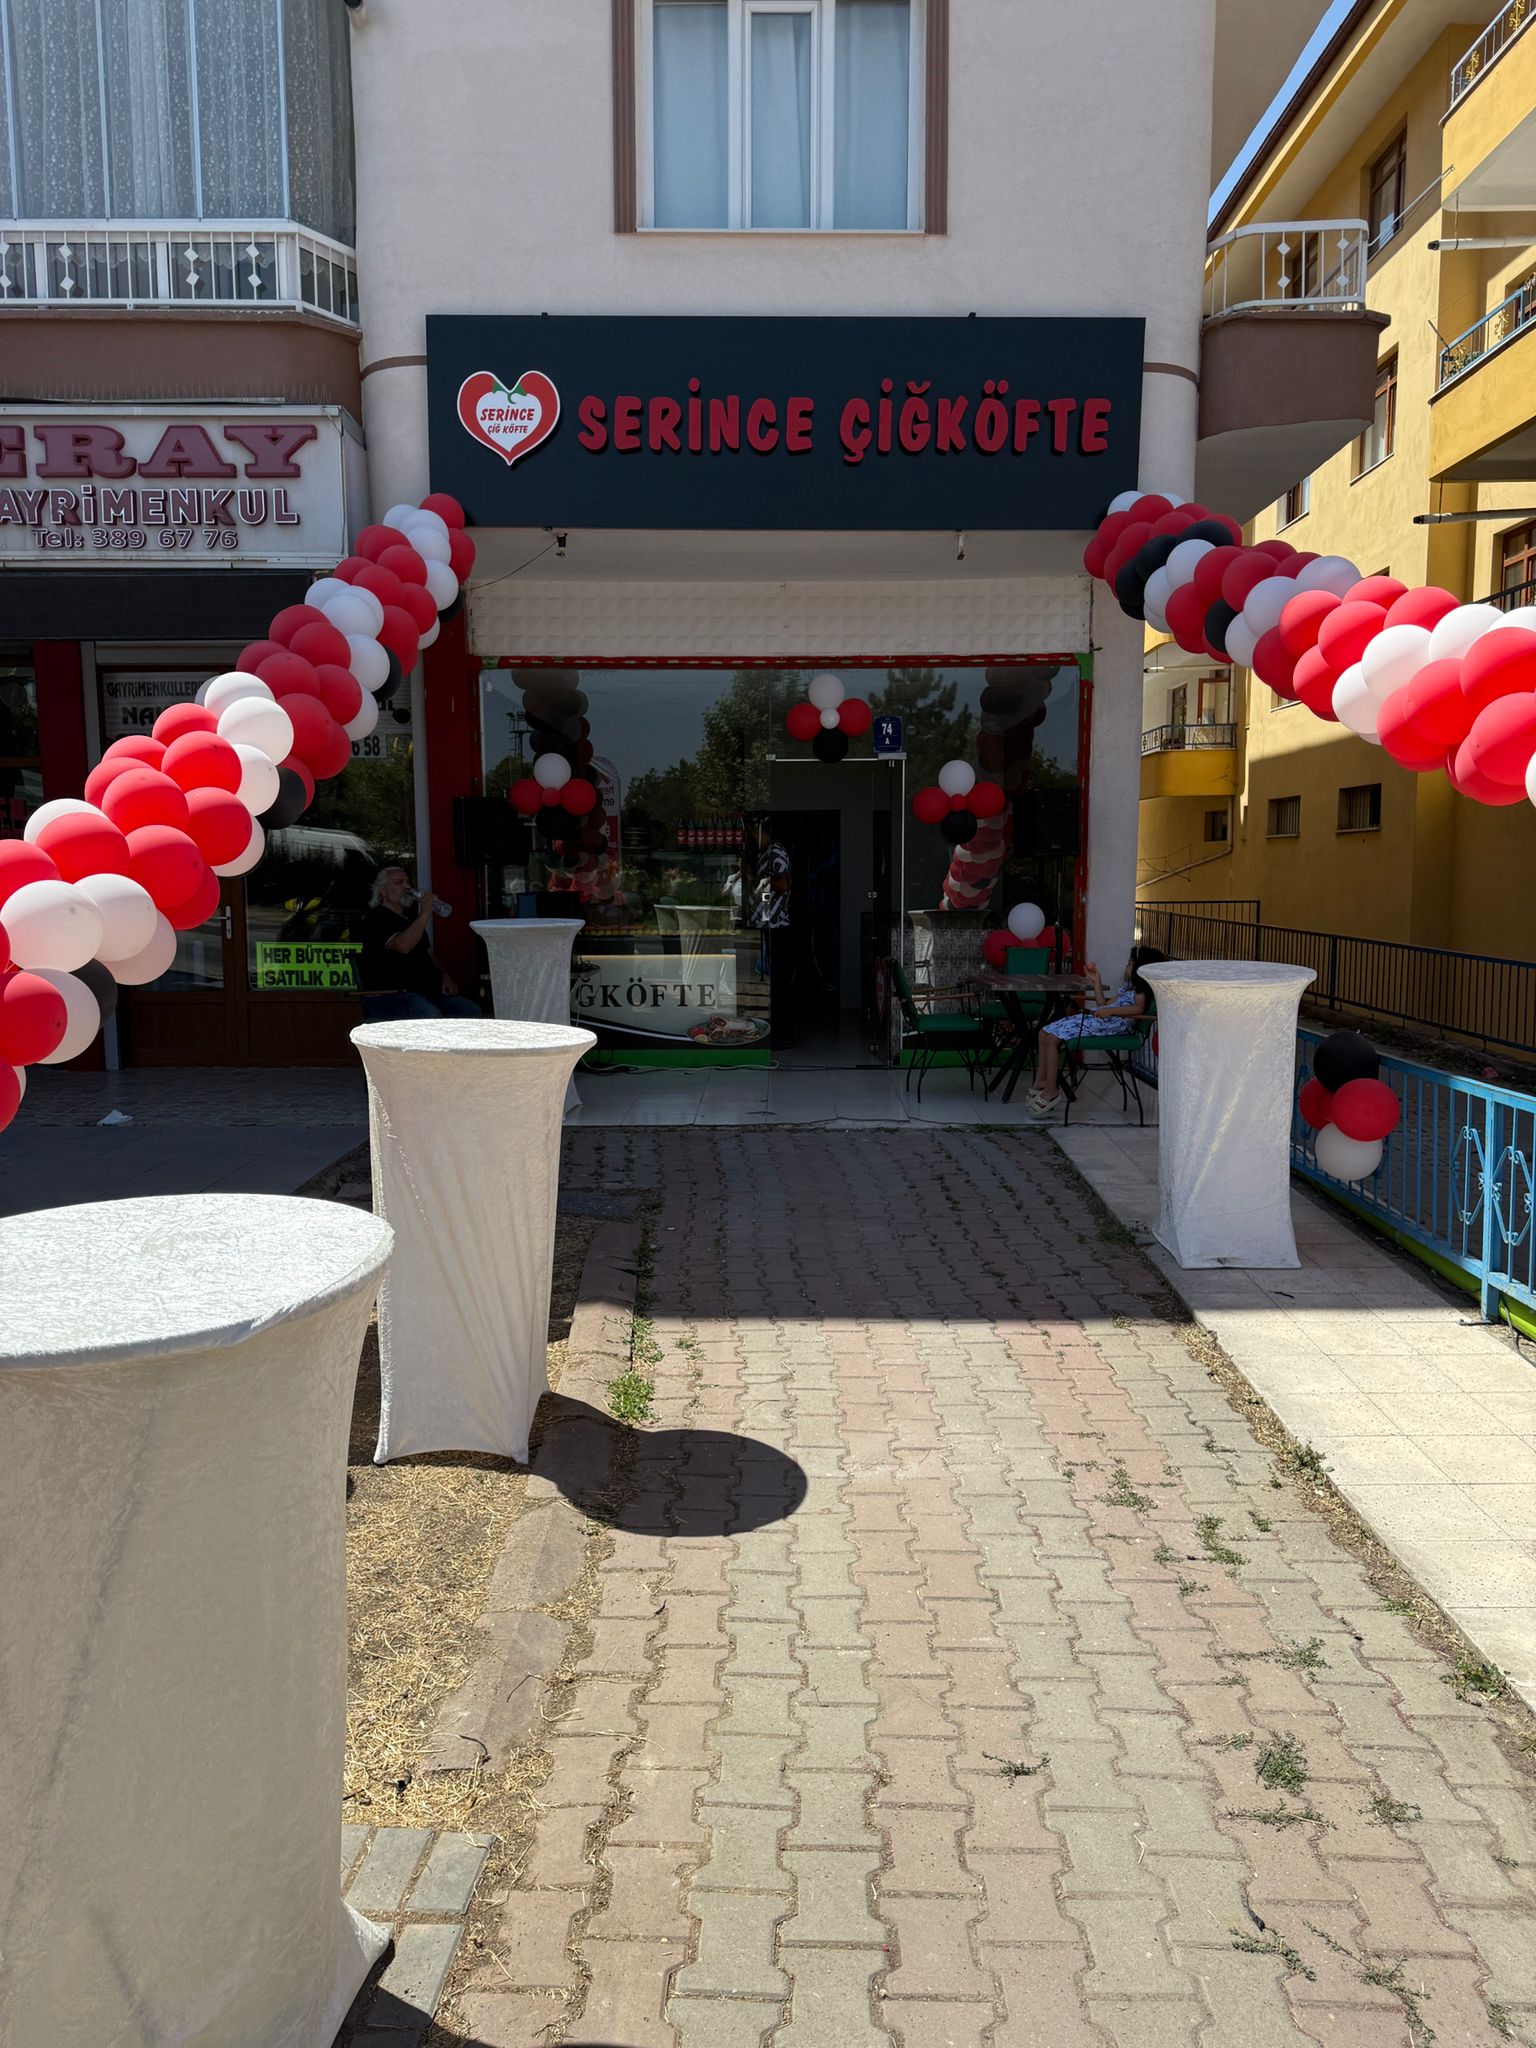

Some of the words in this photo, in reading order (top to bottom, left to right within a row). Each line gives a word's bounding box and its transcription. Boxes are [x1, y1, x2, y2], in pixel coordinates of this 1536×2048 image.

[480, 405, 535, 422] SERİNCE
[578, 377, 815, 452] SERİNCE
[839, 377, 1112, 463] ÇİĞKÖFTE
[502, 423, 529, 434] KÖFTE
[32, 528, 84, 549] Tel:
[92, 528, 147, 549] 389
[158, 528, 194, 549] 67
[202, 528, 239, 549] 76
[881, 722, 893, 735] 74
[364, 735, 380, 756] 58
[884, 737, 891, 745] A
[264, 947, 291, 964] HER
[264, 970, 324, 986] SATILIK
[329, 970, 357, 986] DA
